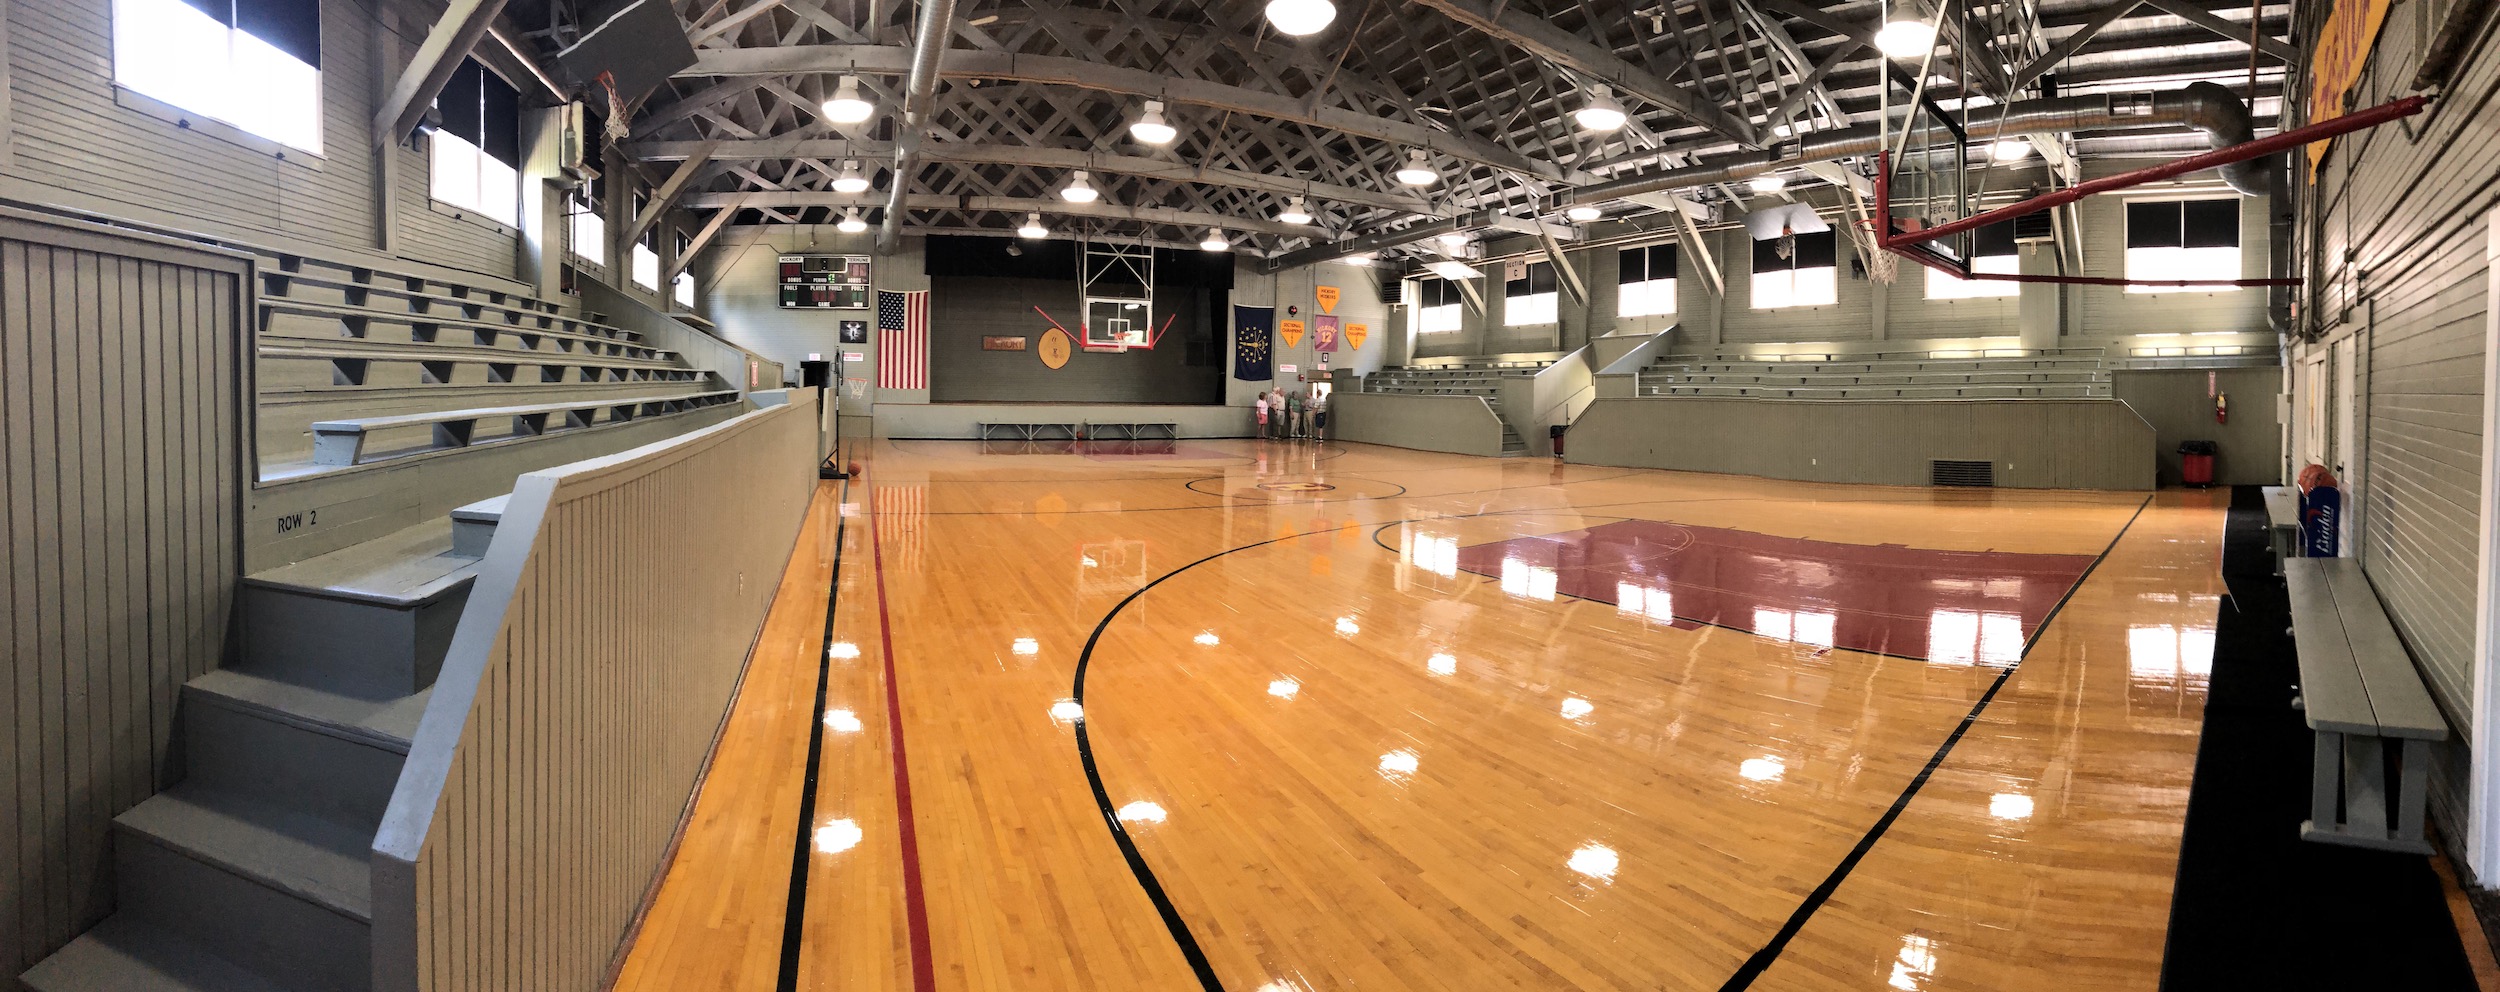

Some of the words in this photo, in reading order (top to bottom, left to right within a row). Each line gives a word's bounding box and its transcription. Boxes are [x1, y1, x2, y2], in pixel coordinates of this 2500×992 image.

[1930, 204, 1956, 214] SECTIO
[1506, 260, 1525, 268] SECTION
[1316, 325, 1337, 334] HICKORY
[1321, 332, 1332, 343] 12
[278, 512, 302, 534] ROW
[310, 510, 317, 526] 2
